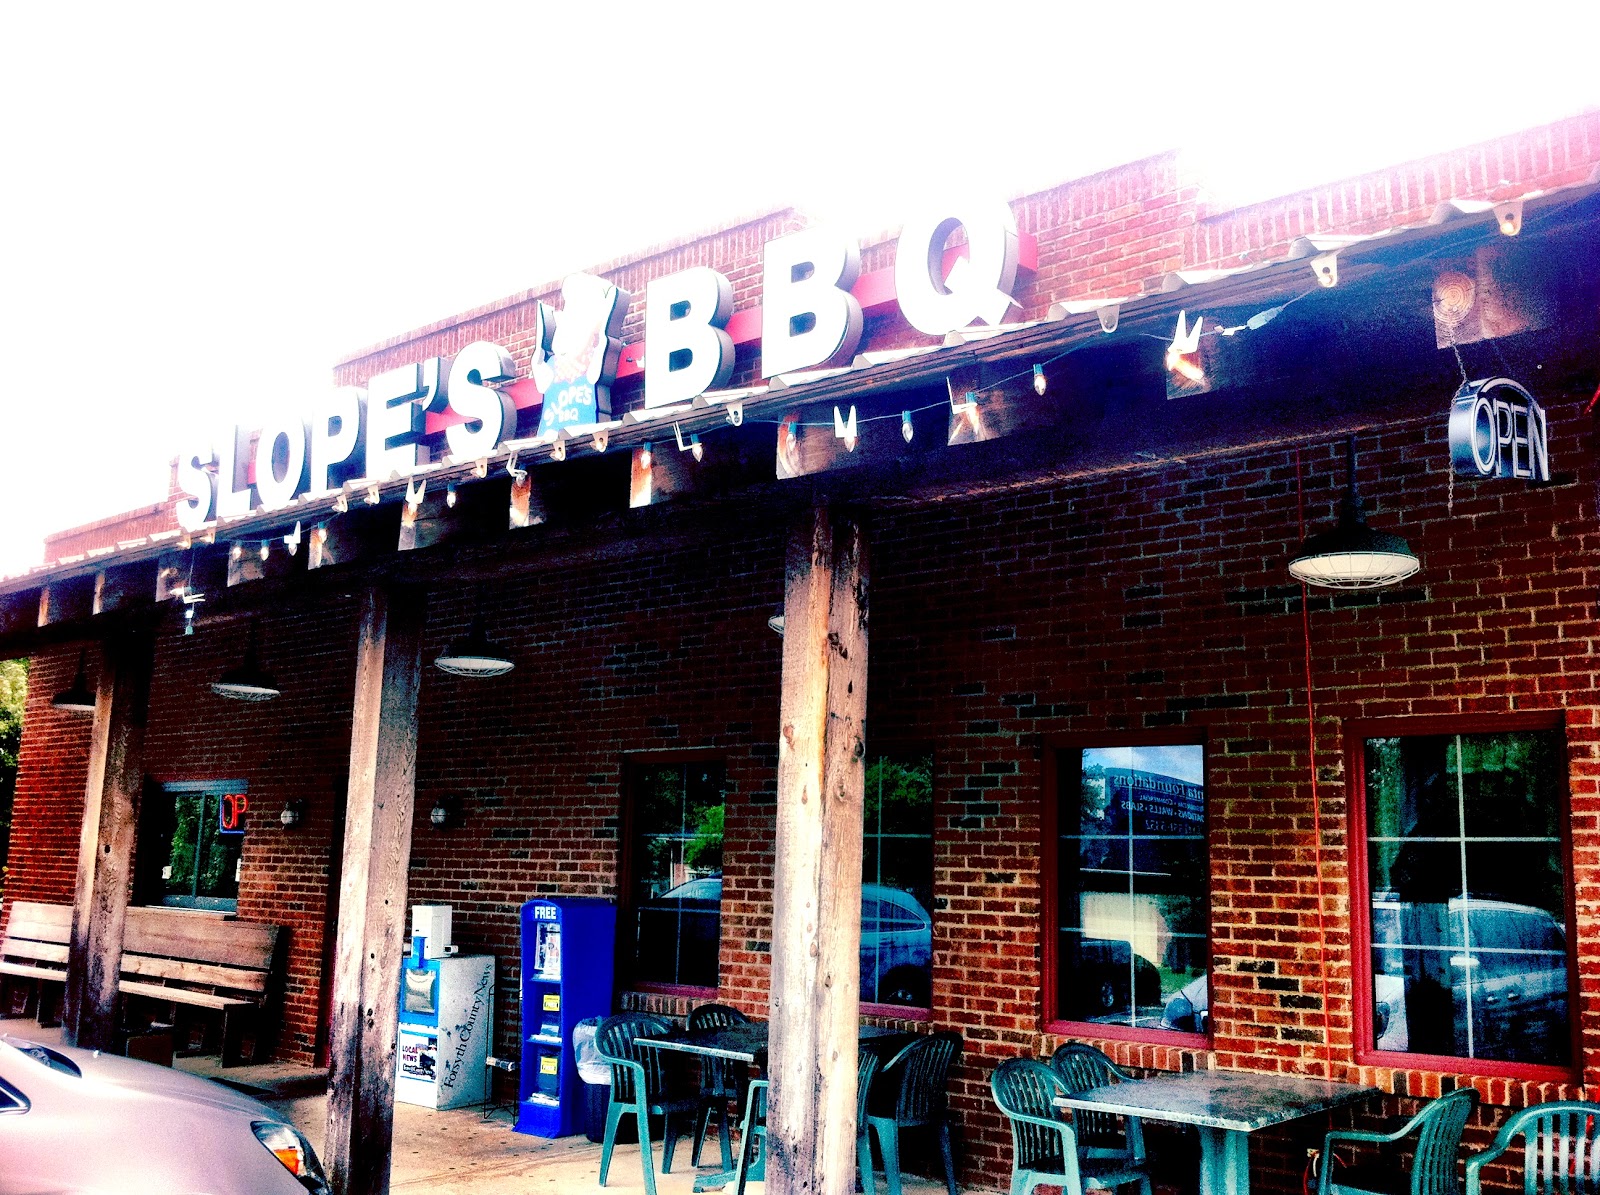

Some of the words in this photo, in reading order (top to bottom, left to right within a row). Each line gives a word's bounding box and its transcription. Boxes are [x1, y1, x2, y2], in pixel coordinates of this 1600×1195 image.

[175, 341, 509, 530] SLOPE'S
[1471, 397, 1549, 481] OPEN
[534, 906, 557, 920] FREE
[443, 1043, 468, 1088] Forsyth
[460, 996, 485, 1042] County
[474, 963, 492, 996] News
